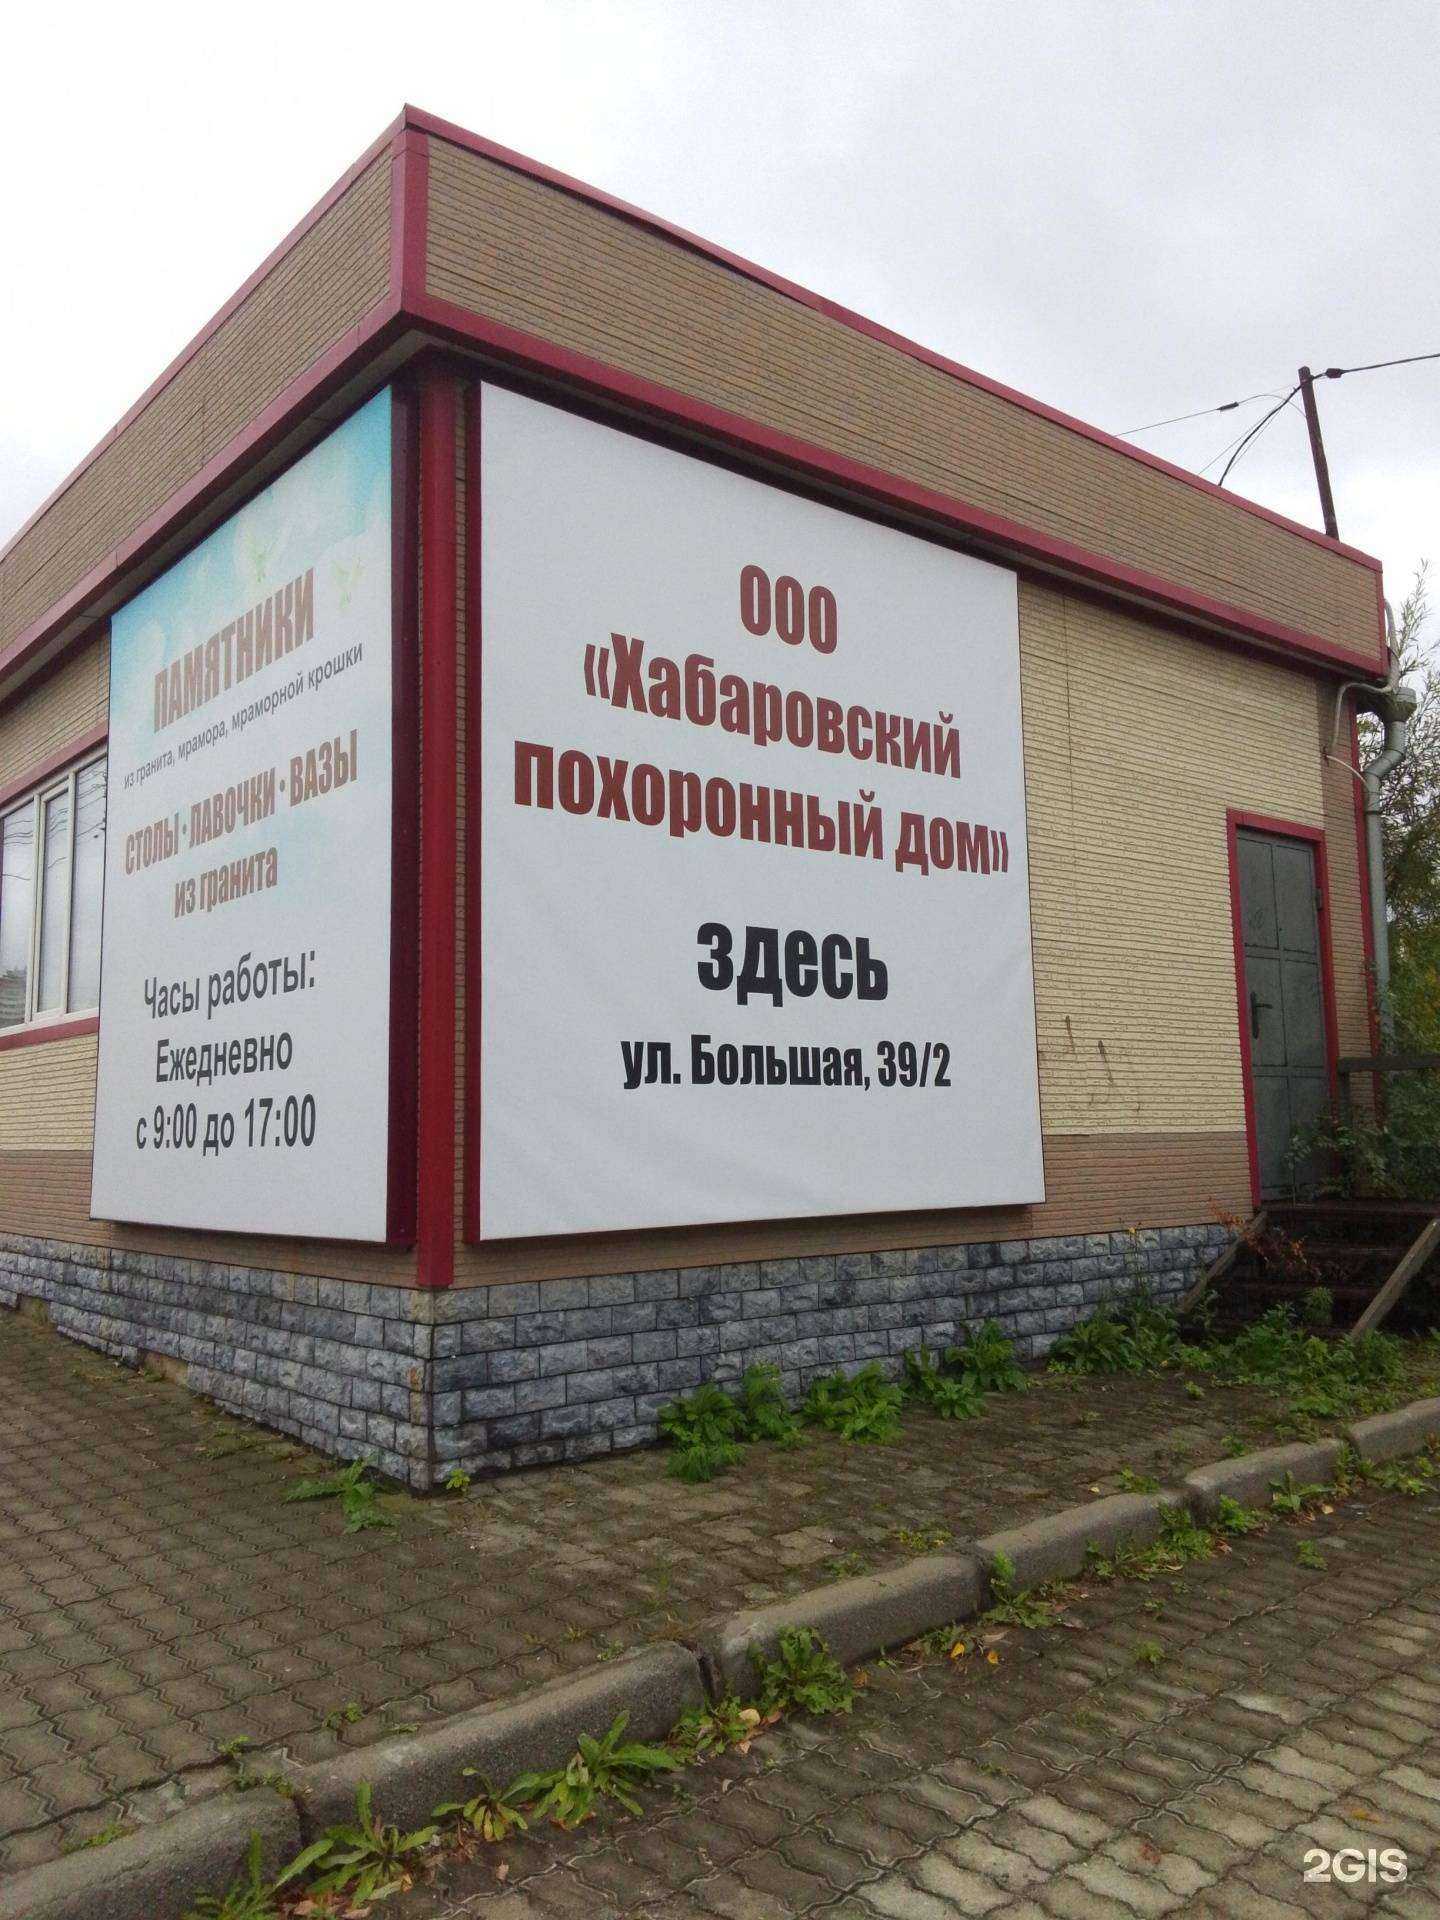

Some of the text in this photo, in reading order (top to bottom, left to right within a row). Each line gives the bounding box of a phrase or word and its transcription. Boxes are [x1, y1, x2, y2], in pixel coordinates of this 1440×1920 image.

[153, 567, 315, 734] ПАМЯТНИКИ
[740, 564, 837, 655] ООО
[123, 643, 363, 790] из гранита, мрамора, мраморной крошки
[583, 632, 961, 779] «Хабаровский
[125, 728, 358, 876] СТОЛЫ ЛАВОЧКИ ВАЗЫ
[514, 740, 1009, 876] похоронный дом»
[174, 846, 278, 919] из гранита
[144, 950, 315, 1020] Часы работы:
[697, 922, 889, 1008] здесь
[156, 1032, 293, 1087] Ежедневно
[621, 1034, 952, 1091] ул. Большая, 39/2
[136, 1093, 316, 1157] с 9:00 до 17:00
